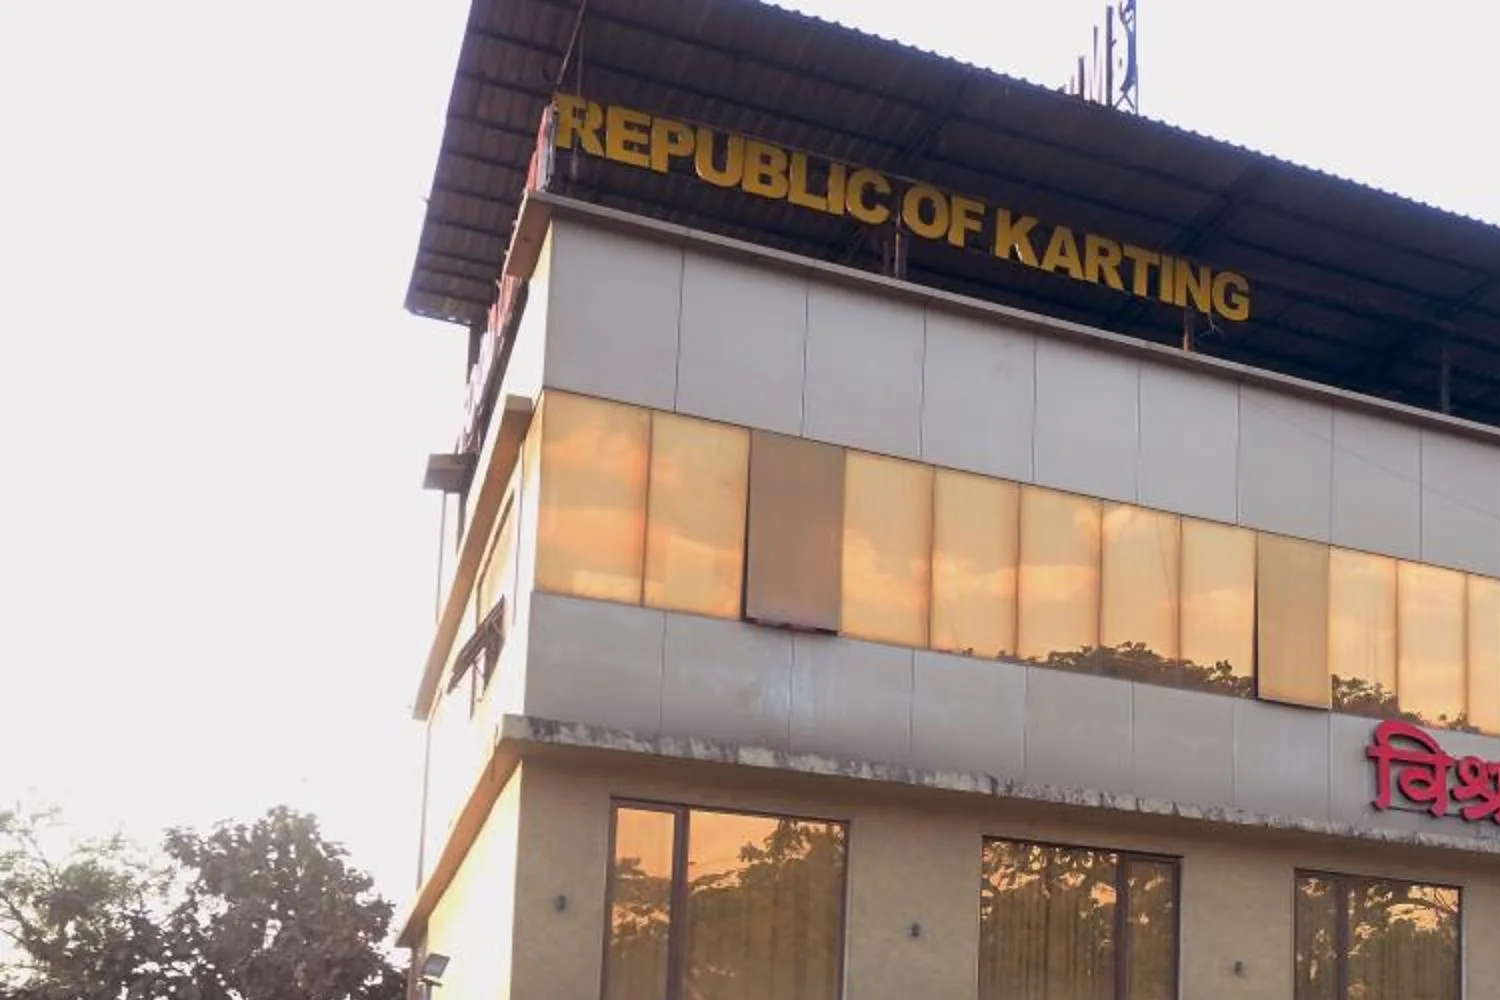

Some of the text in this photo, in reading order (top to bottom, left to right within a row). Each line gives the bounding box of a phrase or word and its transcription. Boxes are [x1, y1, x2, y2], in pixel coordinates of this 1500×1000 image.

[555, 94, 1250, 322] REPUBLIC OF KARTING
